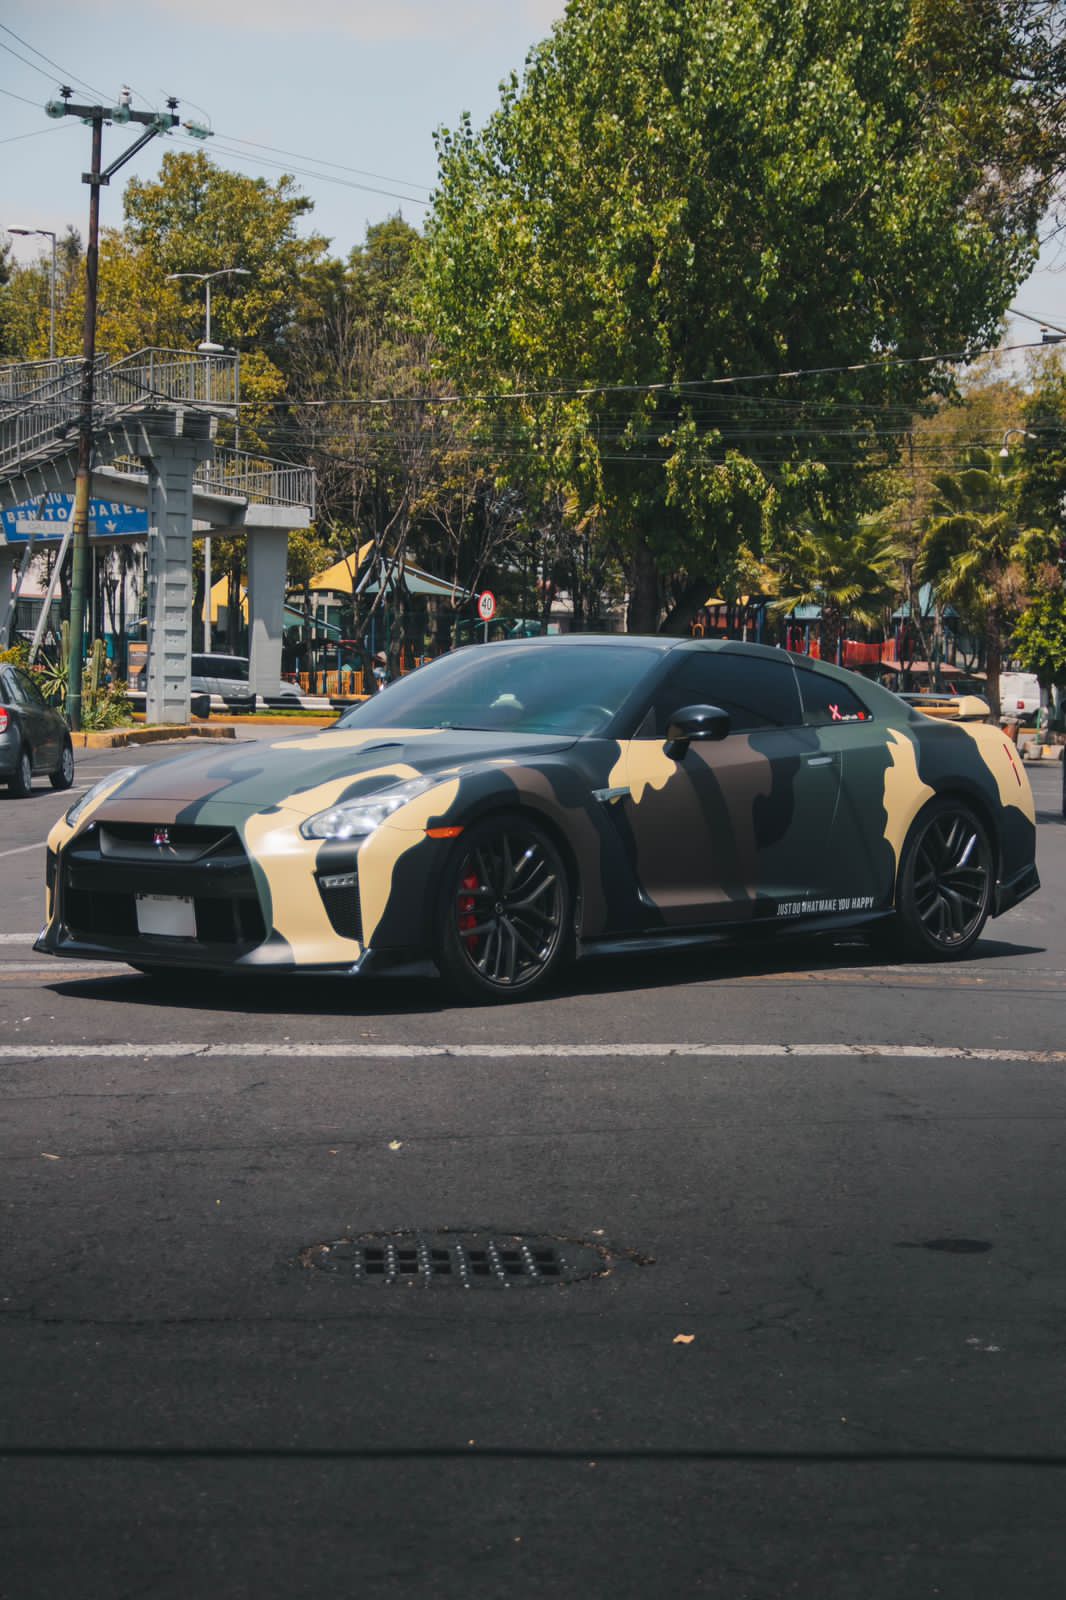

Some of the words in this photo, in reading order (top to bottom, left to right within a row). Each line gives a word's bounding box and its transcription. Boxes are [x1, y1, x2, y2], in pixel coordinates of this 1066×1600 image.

[88, 503, 146, 517] UARE
[481, 597, 492, 610] 40
[777, 903, 792, 916] JUST
[792, 902, 801, 915] DO
[839, 898, 851, 910] YOU
[851, 896, 874, 909] HAPPY
